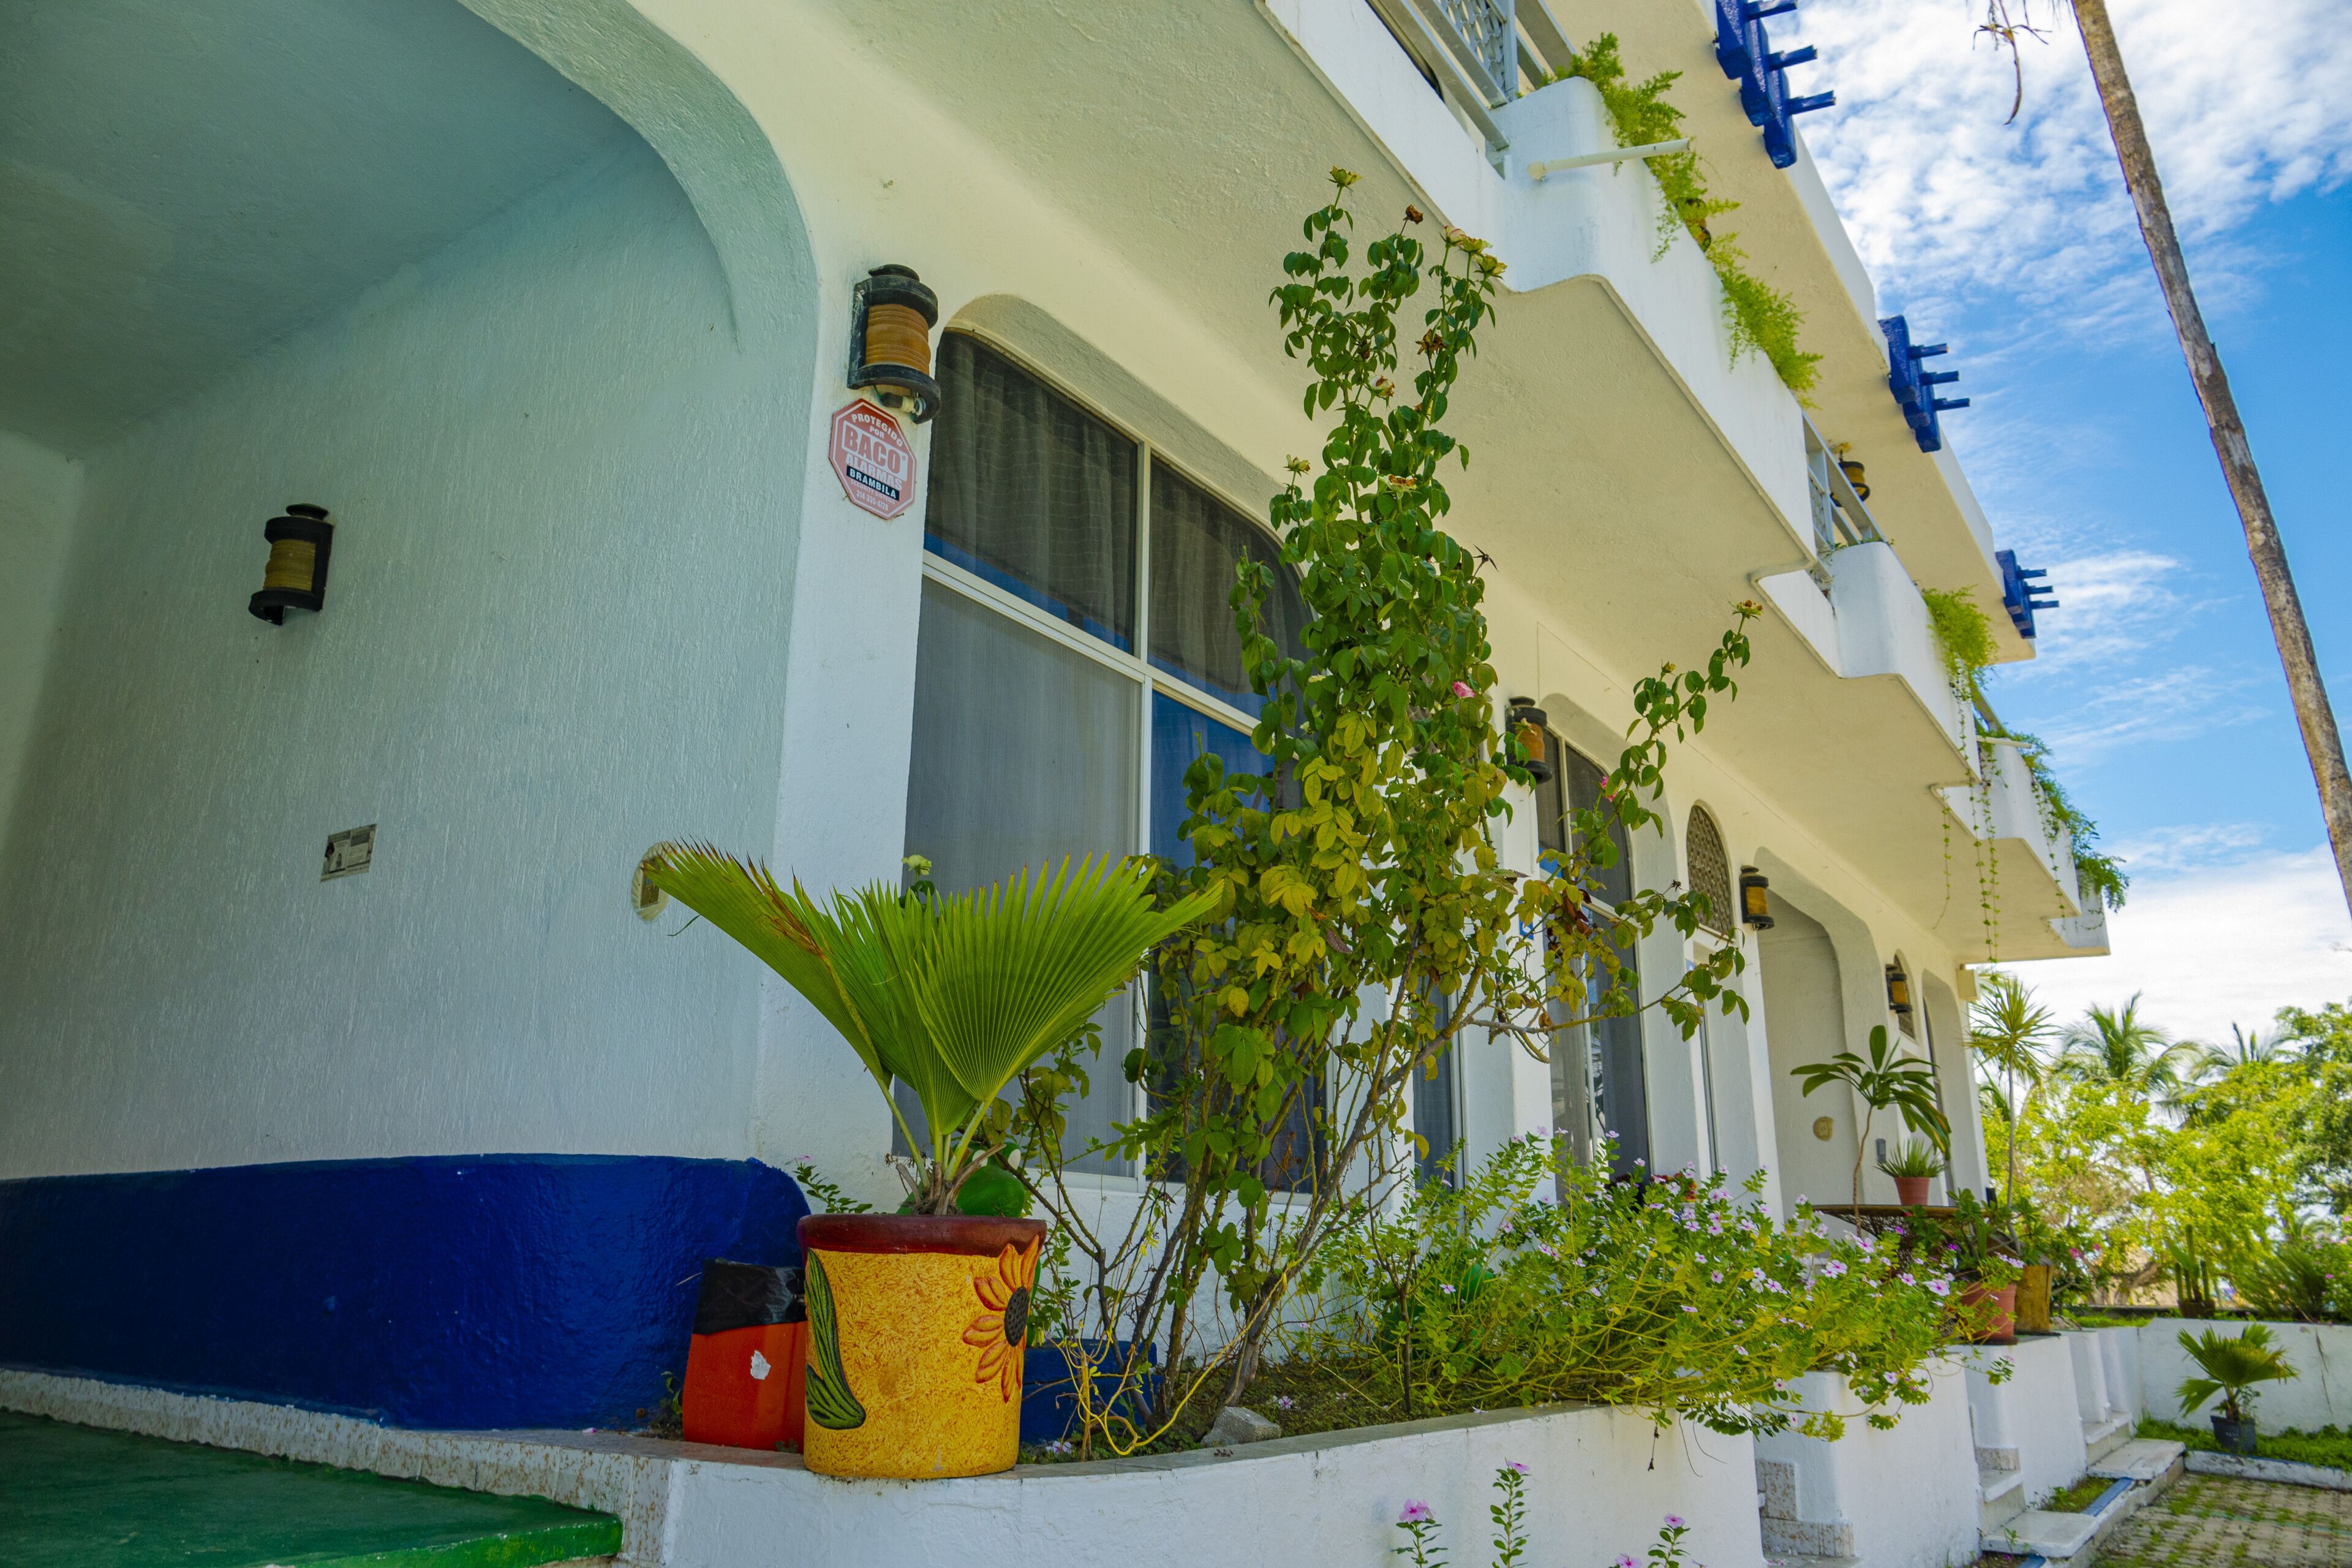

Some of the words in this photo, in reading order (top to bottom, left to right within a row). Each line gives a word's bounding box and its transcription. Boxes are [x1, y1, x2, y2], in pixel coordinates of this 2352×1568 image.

[851, 413, 903, 447] PROTEGIDO
[870, 426, 884, 439] POR
[845, 424, 901, 474] BACO
[845, 453, 902, 491] ALARMAS
[850, 468, 896, 499] BRAMBILA
[850, 478, 874, 494] SECURITY
